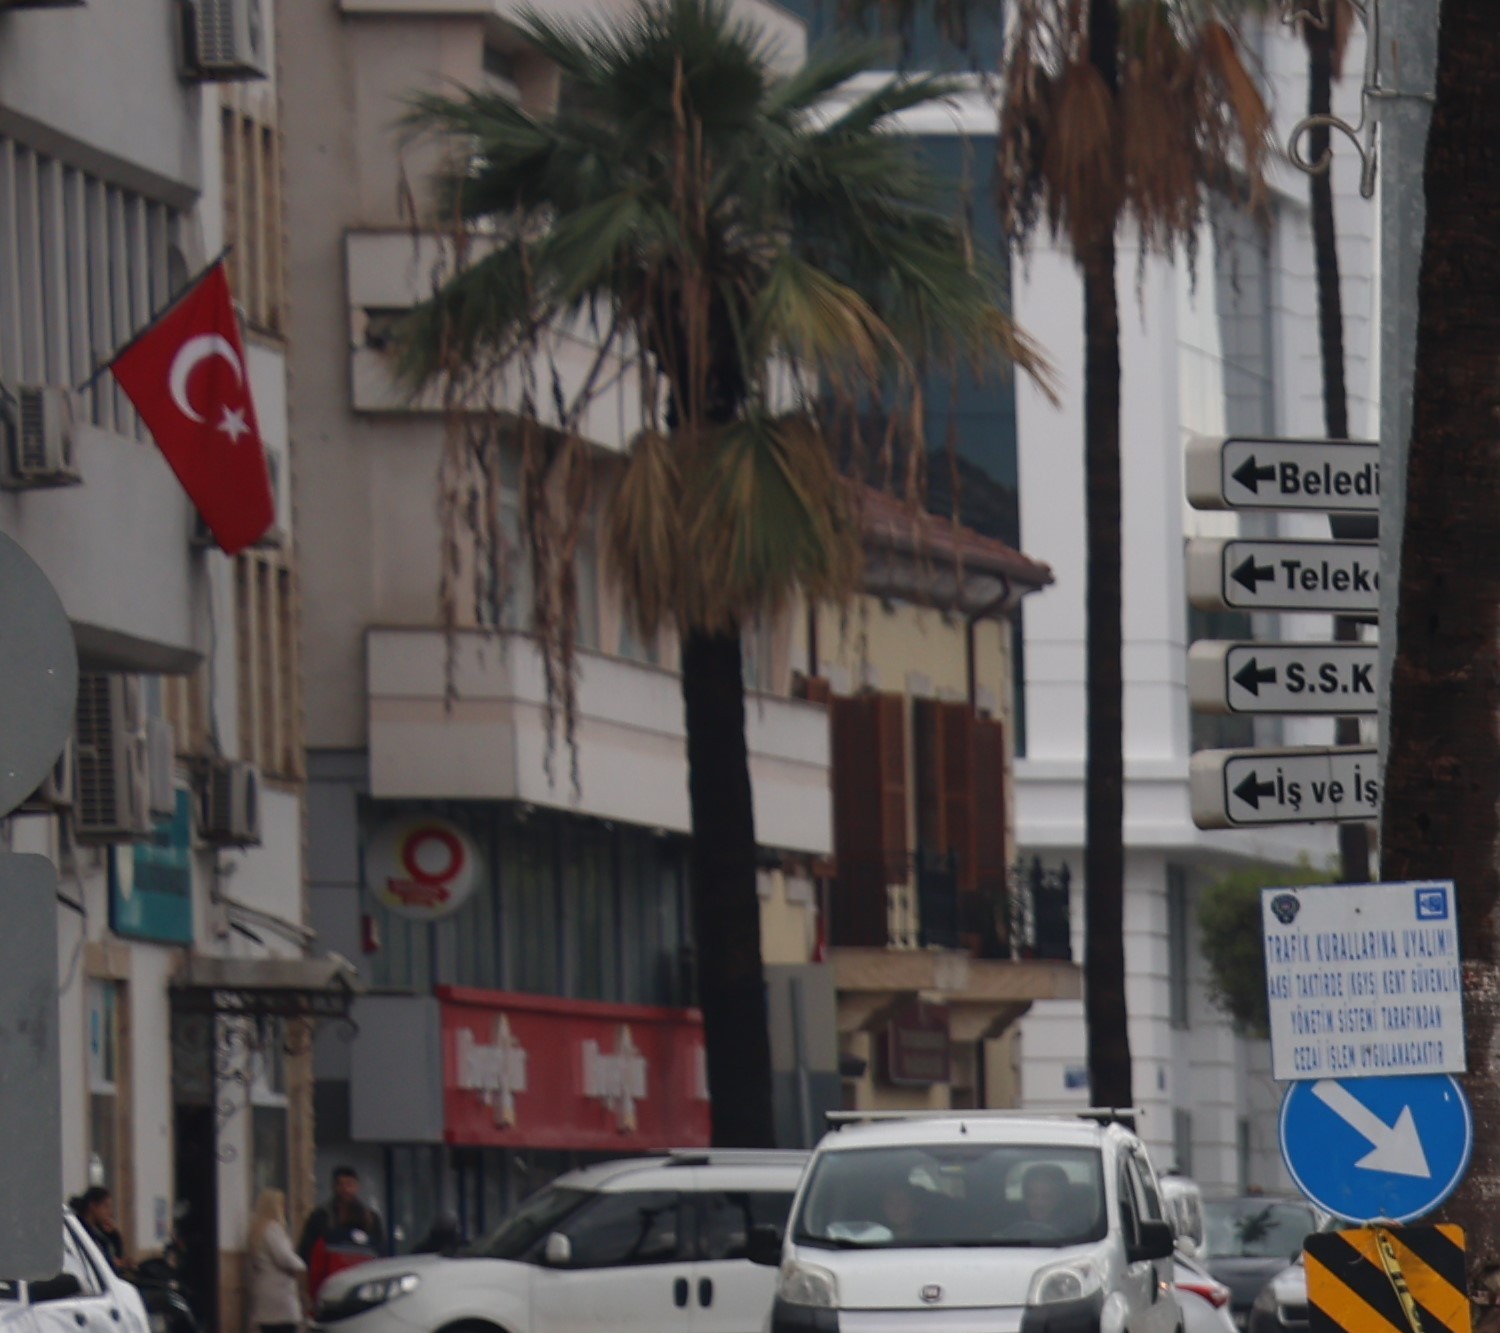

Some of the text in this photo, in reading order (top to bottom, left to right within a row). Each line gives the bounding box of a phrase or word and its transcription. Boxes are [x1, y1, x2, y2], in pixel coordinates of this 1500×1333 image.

[1280, 559, 1380, 591] Telek
[1277, 767, 1301, 811] İş
[1311, 779, 1344, 802] ve
[1267, 927, 1310, 963] TRAFİK
[1316, 930, 1397, 962] KURALLARINA
[1270, 967, 1291, 998] AKSİ
[1296, 966, 1344, 997] TAKTİRDE
[1383, 969, 1406, 995] KENT
[1411, 961, 1459, 994] GÜVENLİK
[1291, 1001, 1442, 1034] YÖNETİM SİSTEMİ TARAFINDAN
[1294, 1038, 1444, 1072] CEZAİ İŞLEM UYGULANACAKTIR
